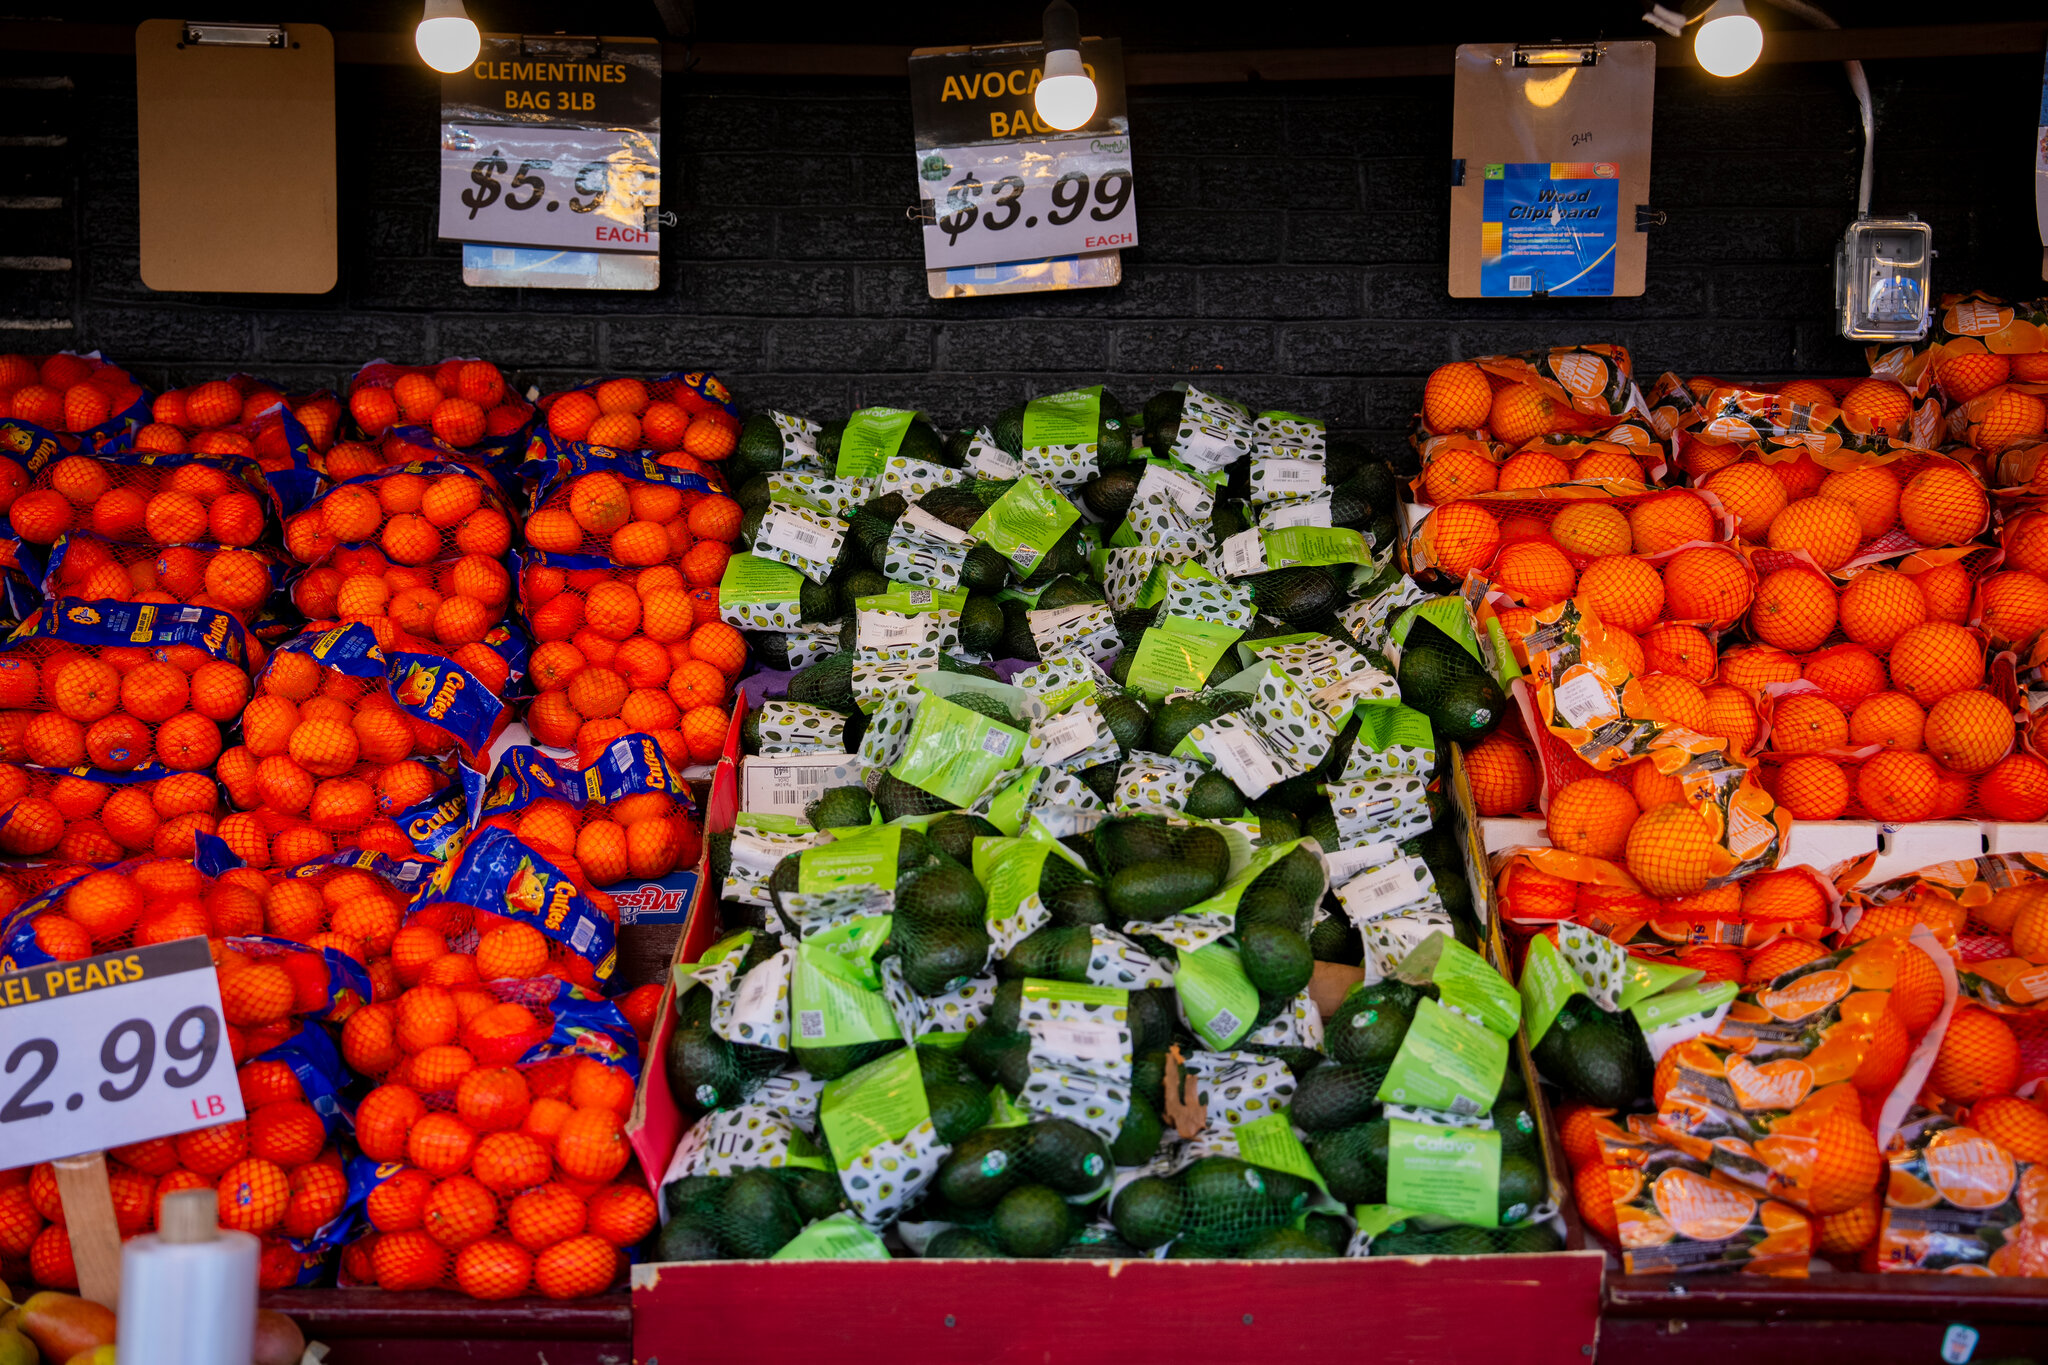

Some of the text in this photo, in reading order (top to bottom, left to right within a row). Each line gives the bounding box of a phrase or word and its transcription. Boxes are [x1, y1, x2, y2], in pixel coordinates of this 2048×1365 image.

[474, 61, 626, 83] CLEMENTINES
[941, 63, 1095, 103] AVOCA
[505, 90, 596, 111] BAG 3LB
[1572, 132, 1593, 146] 2.49
[939, 168, 1133, 246] $3.99
[1508, 205, 1601, 222] Clipboard
[1538, 189, 1591, 203] Wood
[596, 226, 649, 243] EACH
[1085, 233, 1133, 248] EACH
[27, 437, 58, 473] Cuties
[202, 613, 230, 655] Cuties
[428, 671, 466, 721] Cuties
[644, 738, 666, 791] Cuties
[408, 793, 467, 840] Cutie
[543, 880, 577, 932] Cuties
[45, 954, 145, 994] PEARS
[0, 1005, 221, 1123] 2.99
[191, 1094, 226, 1120] LB
[1413, 1134, 1476, 1153] Calavo
